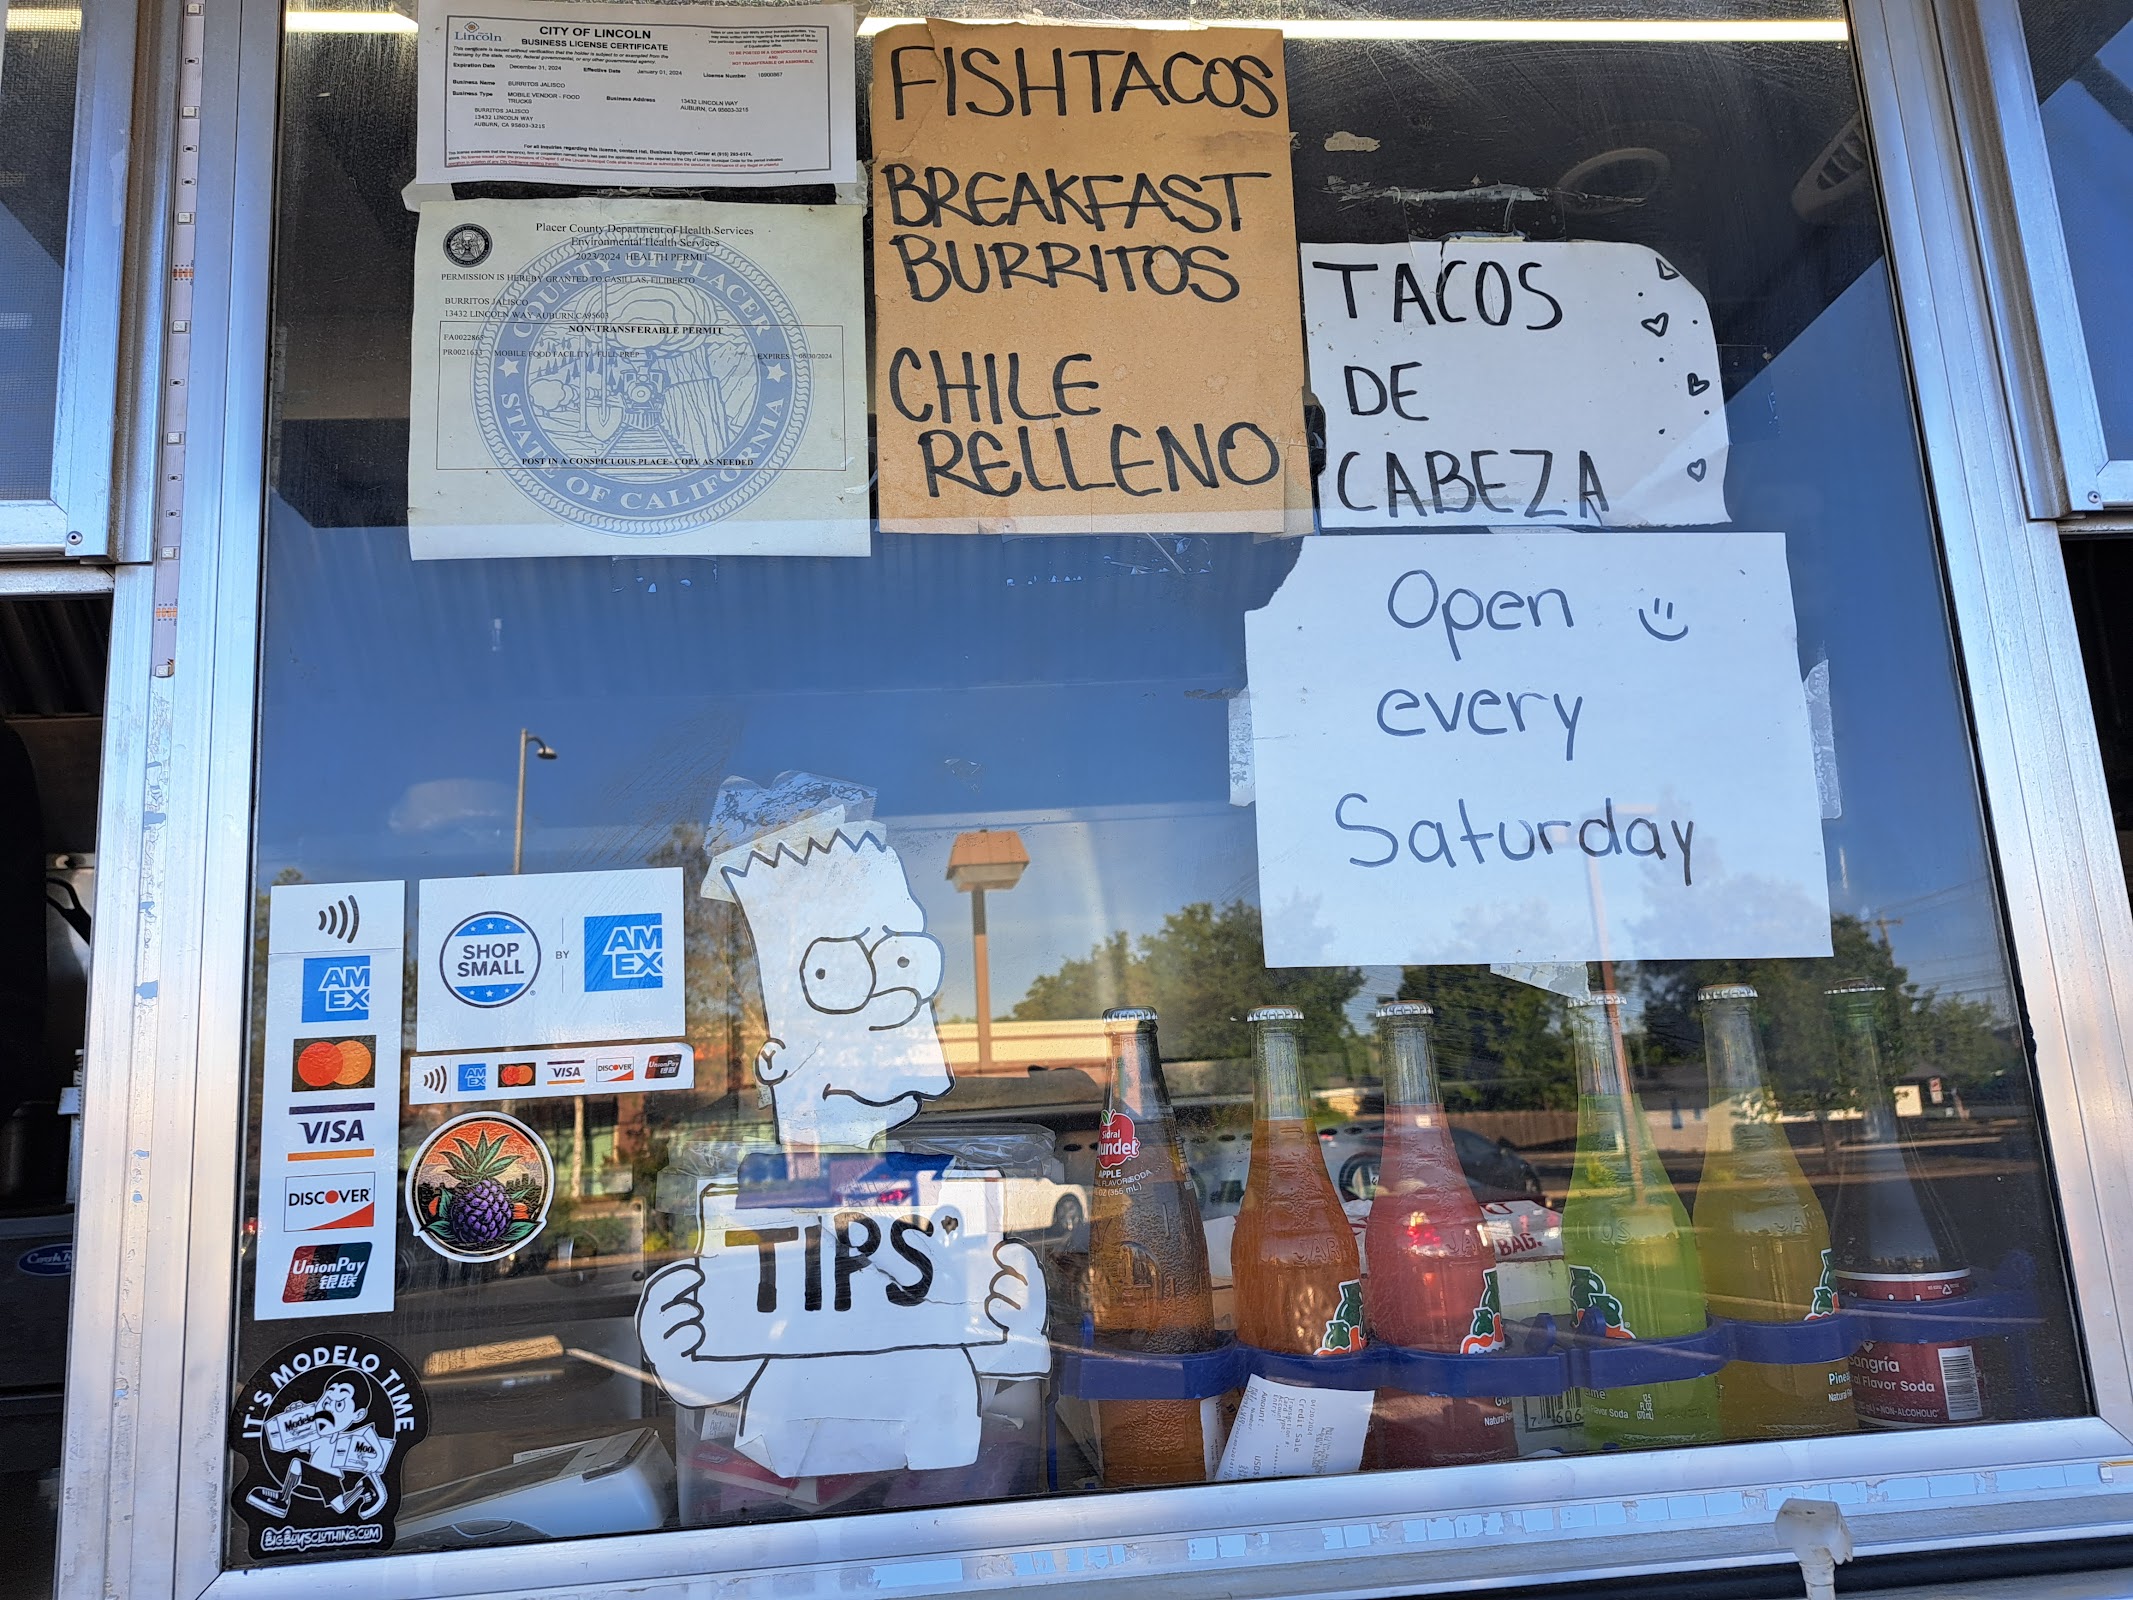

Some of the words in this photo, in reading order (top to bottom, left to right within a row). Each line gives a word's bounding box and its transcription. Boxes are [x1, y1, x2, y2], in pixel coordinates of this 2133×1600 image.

[454, 31, 502, 42] Lincoln
[539, 26, 569, 36] CITY
[572, 27, 591, 37] OF
[594, 28, 651, 40] LINCOLN
[521, 38, 567, 47] BUSINESS
[569, 40, 608, 49] LICENSE
[609, 42, 669, 51] CERTIFICATE
[453, 62, 481, 70] Expiration
[509, 63, 537, 71] December
[538, 65, 547, 73] 31,
[680, 105, 708, 113] AUBURN,
[474, 121, 500, 129] AUBURN,
[880, 163, 1272, 234] BREAKFAST
[535, 222, 566, 233] Placer
[569, 223, 604, 236] County
[607, 224, 662, 237] Department
[665, 225, 678, 235] of
[679, 226, 710, 236] Health
[713, 226, 754, 236] Services
[571, 237, 642, 247] Environmental
[645, 237, 678, 247] Health
[679, 238, 720, 249] Services
[575, 252, 621, 262] 2023/2024
[625, 253, 669, 262] HEALTH
[670, 253, 709, 262] PERMIT
[888, 233, 1241, 303] BURRITOS
[441, 273, 495, 281] PERMISSION
[496, 273, 505, 281] IS
[507, 274, 544, 283] HEREBY
[545, 275, 589, 283] GRANTED
[590, 275, 603, 283] TO
[603, 275, 650, 284] CASILLAS,
[650, 276, 696, 284] FILIBERTO
[444, 297, 490, 305] BURRITOS
[491, 298, 529, 306] JALISCO
[513, 256, 613, 338] COUNTY
[625, 250, 667, 268] OF
[672, 252, 771, 337] PLACER
[1312, 260, 1564, 330] TACOS
[444, 309, 468, 318] 13432
[469, 310, 509, 318] LINCOLN
[511, 311, 533, 319] WAY
[443, 333, 485, 341] FA0022865
[568, 325, 680, 335] NON-TRANSFERABLE
[682, 326, 723, 335] PERMIT
[442, 348, 483, 357] PR0021633
[494, 350, 527, 358] MOBILE
[528, 350, 552, 358] FOOD
[553, 350, 590, 358] FACILITY
[597, 350, 618, 358] FULL
[619, 350, 640, 358] PREP
[888, 346, 1101, 425] CHILE
[1343, 361, 1430, 422] DE
[501, 392, 556, 478] STATE
[566, 476, 612, 503] OF
[620, 398, 785, 510] CALIFORNIA
[918, 421, 1280, 498] RELLENO
[521, 457, 545, 465] POST
[560, 458, 569, 466] A
[569, 458, 636, 466] CONSPICUOUS
[674, 458, 700, 467] COPY
[702, 458, 714, 467] AS
[716, 459, 754, 467] NEEDED
[1336, 448, 1610, 519] CABEZA
[1387, 568, 1575, 662] Open
[1375, 687, 1583, 762] every
[1334, 792, 1695, 887] Saturday
[606, 925, 663, 952] AM
[462, 942, 520, 960] SHOP
[554, 949, 570, 961] BY
[456, 959, 525, 978] SMALL
[613, 951, 663, 980] EX
[321, 966, 370, 988] AM
[325, 988, 370, 1012] EX
[551, 1066, 581, 1078] VISA
[597, 1063, 633, 1072] DISCOVER
[648, 1060, 680, 1070] UnionPay
[298, 1119, 365, 1144] VISA
[1102, 1130, 1120, 1139] Sidral
[1101, 1177, 1128, 1187] FLAVOR
[1127, 1169, 1153, 1182] SODA
[288, 1187, 370, 1207] DISCOVER
[1496, 1232, 1544, 1257] BAG.
[292, 1256, 366, 1279] UnionPay
[724, 1211, 936, 1314] TIPS
[318, 1274, 358, 1290] 银联
[269, 1345, 381, 1390] MODELO
[1861, 1375, 1897, 1391] Flavor
[1900, 1380, 1935, 1393] Soda
[381, 1368, 415, 1433] TIME
[242, 1389, 273, 1439] IT'S
[1285, 1397, 1296, 1438] Transaction
[1297, 1398, 1307, 1429] Credit
[1307, 1398, 1317, 1437] 04/20/2024
[1608, 1408, 1629, 1419] Soda
[1293, 1431, 1303, 1453] Sale
